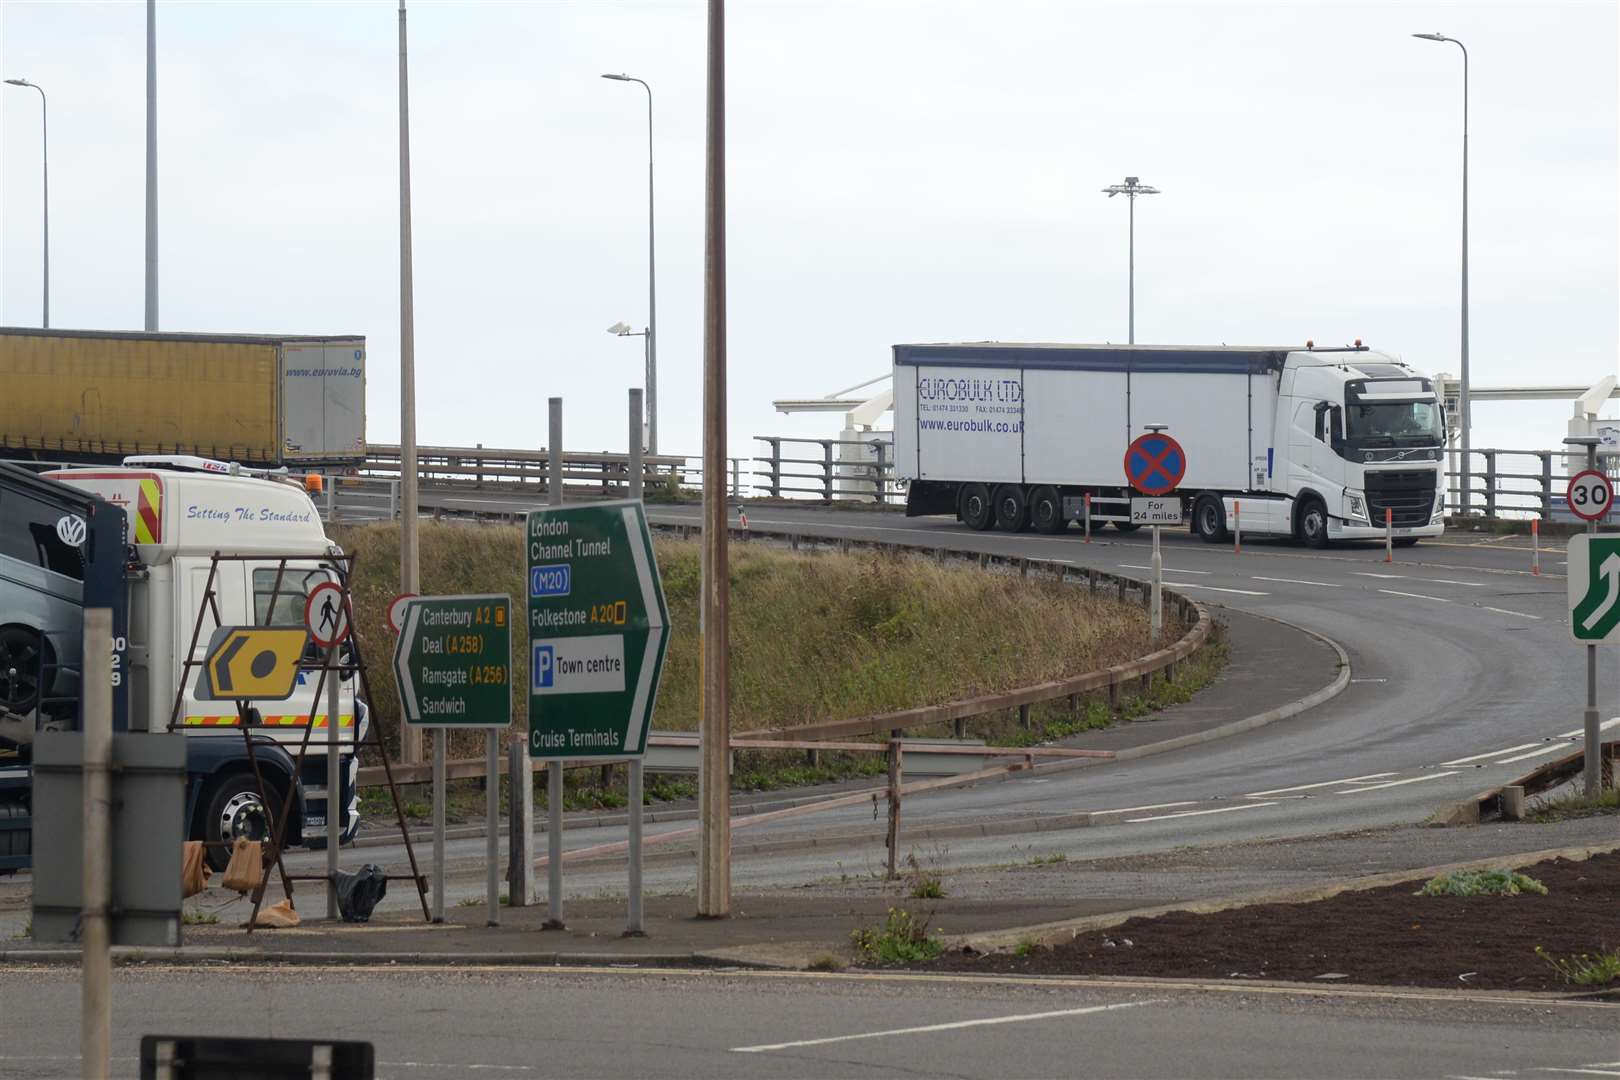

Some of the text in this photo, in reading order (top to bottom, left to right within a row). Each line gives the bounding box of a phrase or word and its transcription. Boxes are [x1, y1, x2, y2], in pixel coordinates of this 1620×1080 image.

[287, 367, 362, 377] www.eurovia.bg
[919, 378, 993, 401] EUROBULK
[919, 419, 1025, 433] www.eurobulk.co.uk
[1147, 501, 1164, 509] For
[1574, 485, 1607, 505] 30
[187, 506, 311, 522] Setting The Standard
[1134, 511, 1178, 521] 24 miles
[531, 518, 569, 537] London
[531, 536, 611, 560] Channel Tunnel
[533, 568, 568, 593] (M20)
[423, 608, 472, 628] Canterbury
[531, 607, 586, 627] Folkestone
[422, 636, 443, 653] Deal
[539, 650, 551, 684] P
[556, 654, 621, 674] Town centre
[422, 666, 467, 687] Ramsgate
[422, 696, 465, 713] Sandwich
[532, 727, 619, 748] Cruise Terminals
